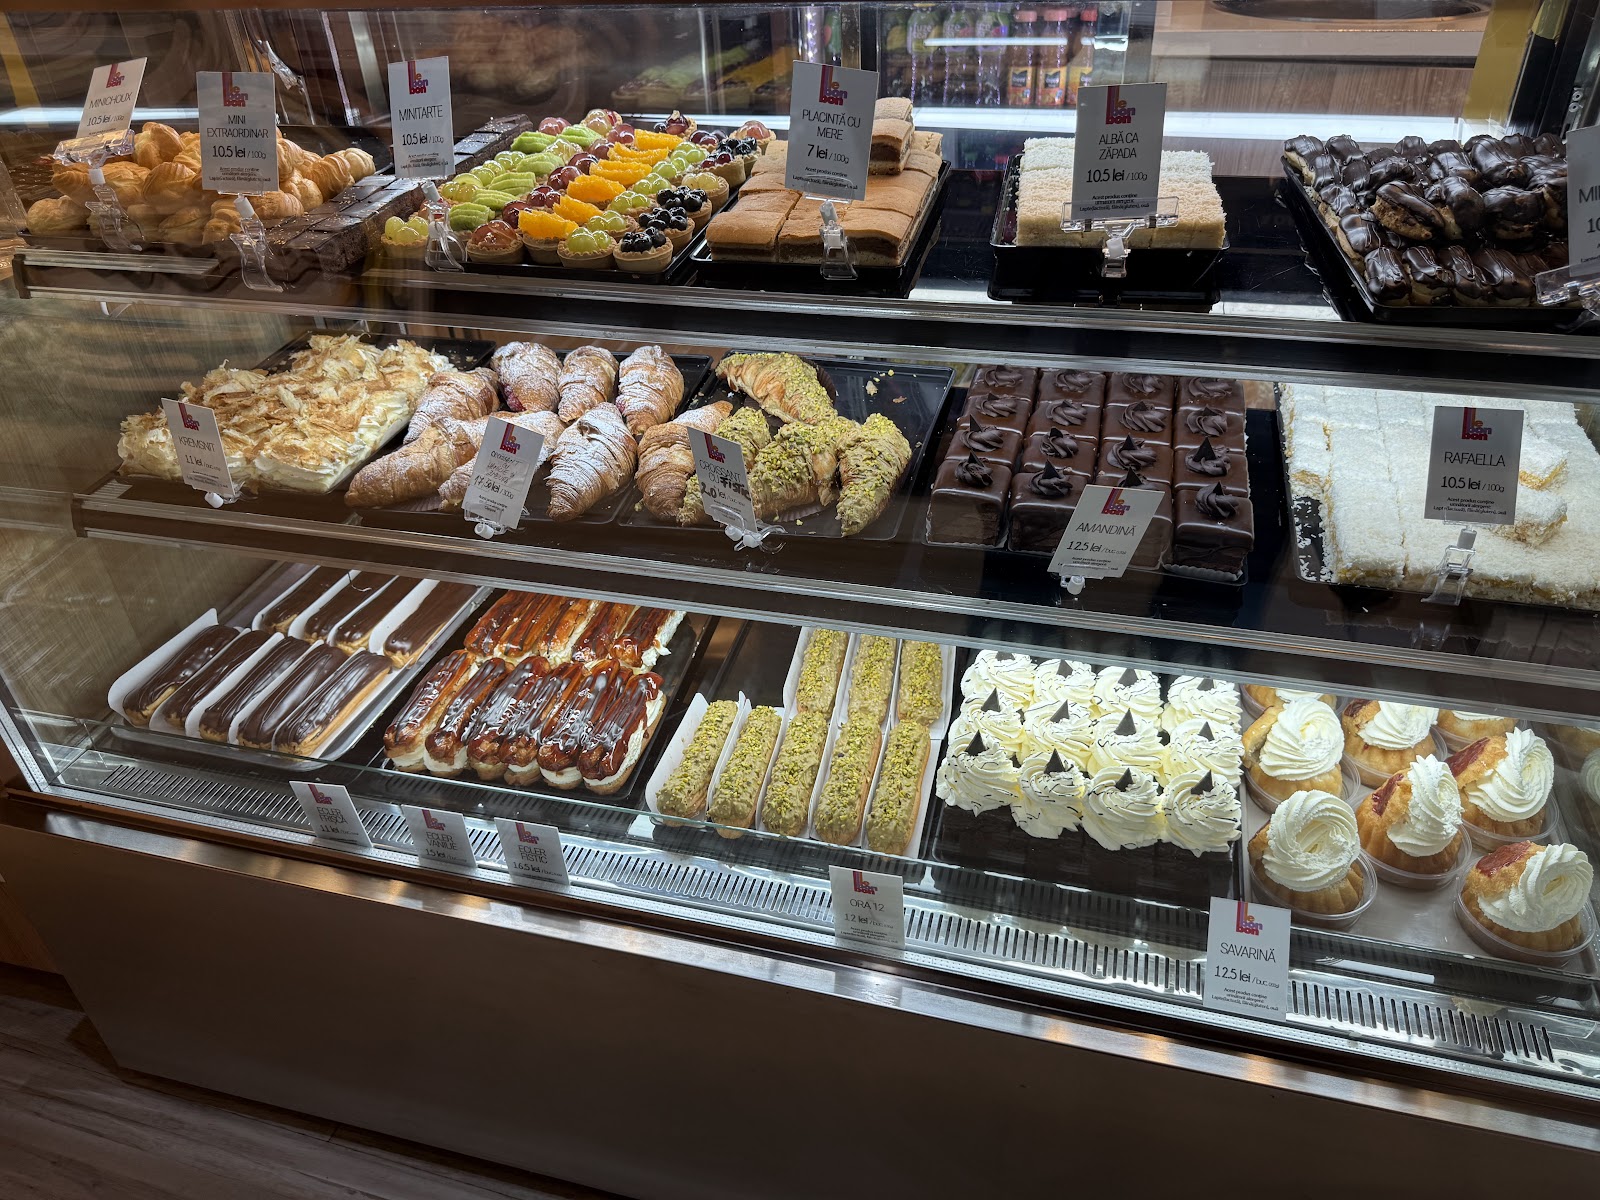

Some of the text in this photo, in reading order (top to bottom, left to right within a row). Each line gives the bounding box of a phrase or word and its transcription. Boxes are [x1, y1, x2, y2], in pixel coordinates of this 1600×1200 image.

[89, 92, 132, 109] MINICHOUX
[398, 105, 443, 121] MINITARTE
[228, 115, 246, 125] MINI
[847, 117, 861, 128] CU
[207, 128, 269, 139] EXTRAORDINAR
[817, 126, 843, 140] MERE
[1099, 131, 1139, 145] ALBĂ CA
[212, 146, 233, 158] 10.5
[235, 146, 246, 158] lei
[808, 144, 815, 157] 7
[816, 146, 828, 160] lei
[1099, 147, 1137, 160] ZĂPADA
[1086, 169, 1110, 183] 10.5
[1112, 168, 1125, 181] lei
[186, 455, 195, 465] 11
[1444, 452, 1506, 467] RAFAELLA
[1441, 476, 1465, 489] 10.5
[1468, 478, 1481, 490] lei
[1487, 484, 1505, 493] 100g
[1076, 522, 1137, 536] AMANDINĂ
[1090, 543, 1102, 552] lei
[320, 824, 330, 833] 11
[426, 832, 453, 842] ECLER
[426, 839, 458, 851] VANILIE
[518, 845, 547, 857] ECLER
[521, 853, 548, 864] FISTIC
[850, 899, 885, 912] ORA 12
[844, 914, 856, 923] 12
[858, 916, 868, 925] lei
[1220, 942, 1276, 963] SAVARINĂ
[1215, 966, 1237, 980] 12.5
[1240, 970, 1251, 983] lei
